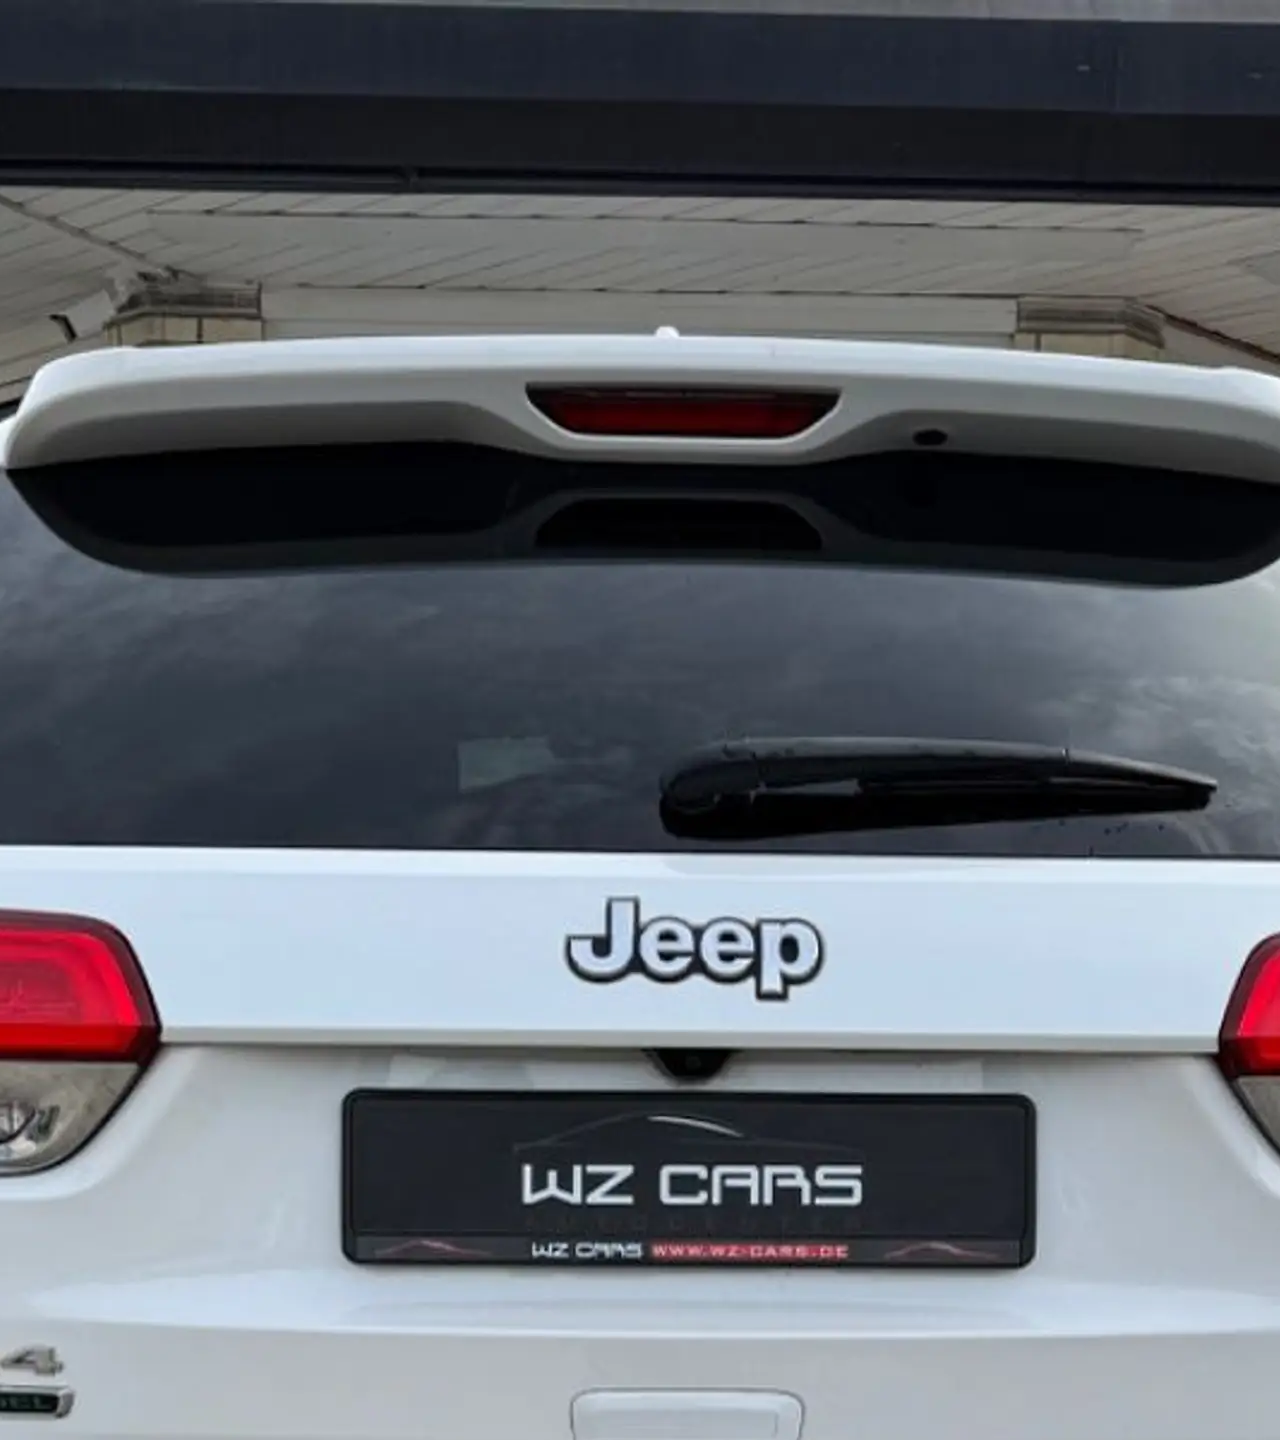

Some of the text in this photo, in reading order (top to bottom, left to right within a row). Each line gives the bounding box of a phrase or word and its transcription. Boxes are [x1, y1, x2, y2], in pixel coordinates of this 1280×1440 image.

[565, 897, 824, 1001] Jeep
[522, 1163, 863, 1206] WZ CARS
[531, 1241, 850, 1259] WZ CARS WWW.WZ-CARS.DE
